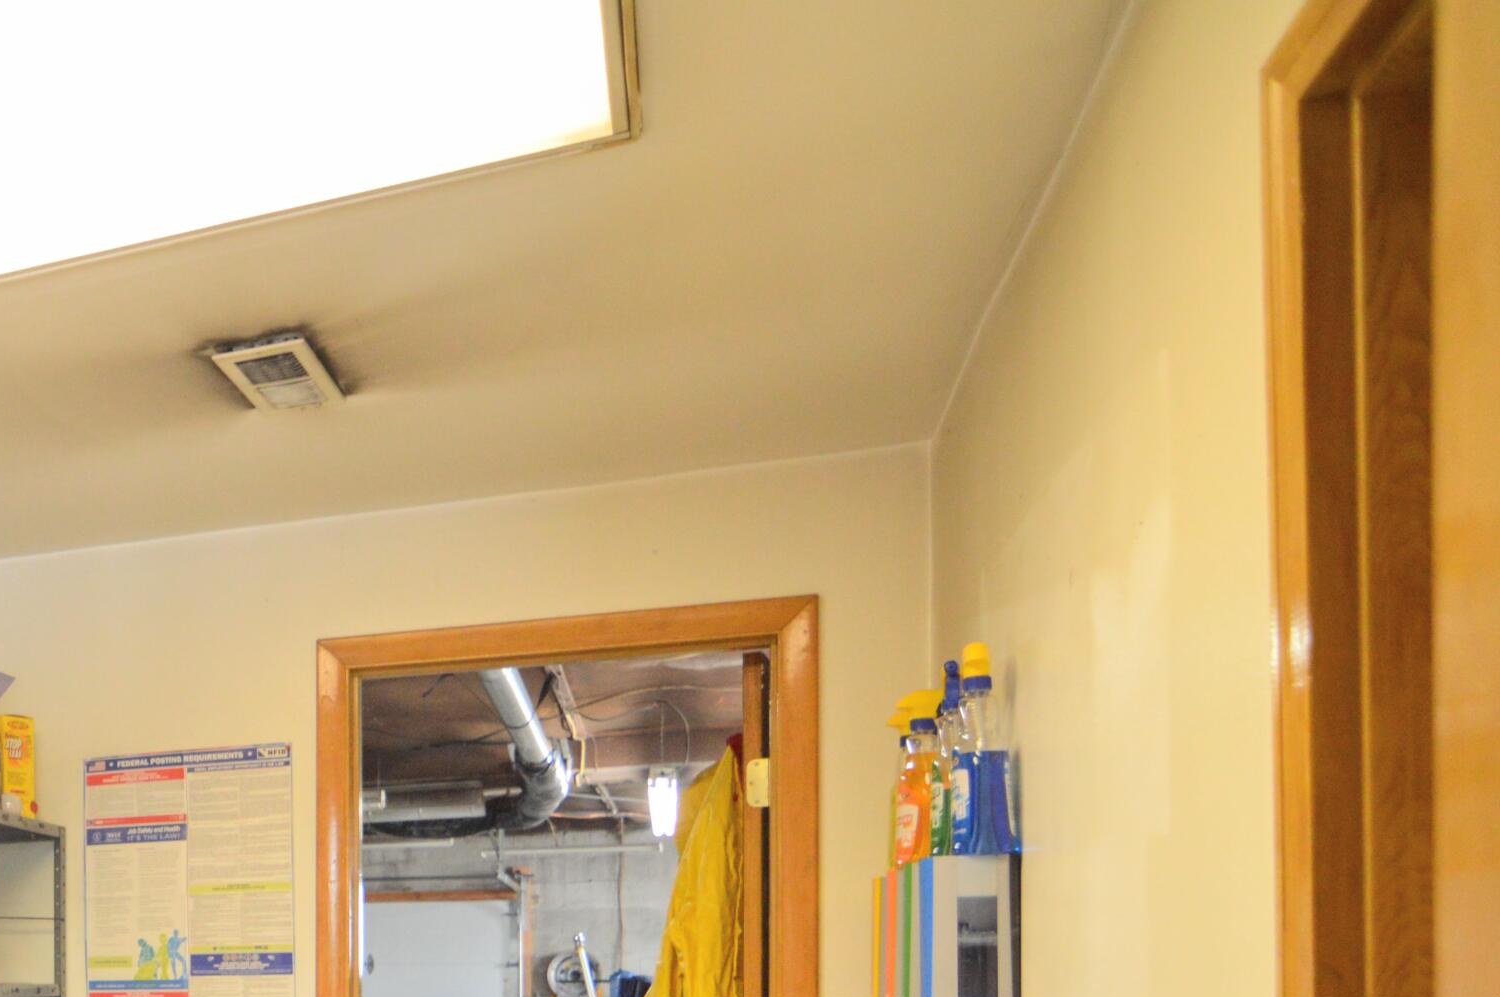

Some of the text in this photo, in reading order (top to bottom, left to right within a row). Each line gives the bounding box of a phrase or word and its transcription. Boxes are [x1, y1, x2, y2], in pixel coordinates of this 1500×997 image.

[116, 751, 244, 768] FEDERAL POSTING REQUIREMENTS
